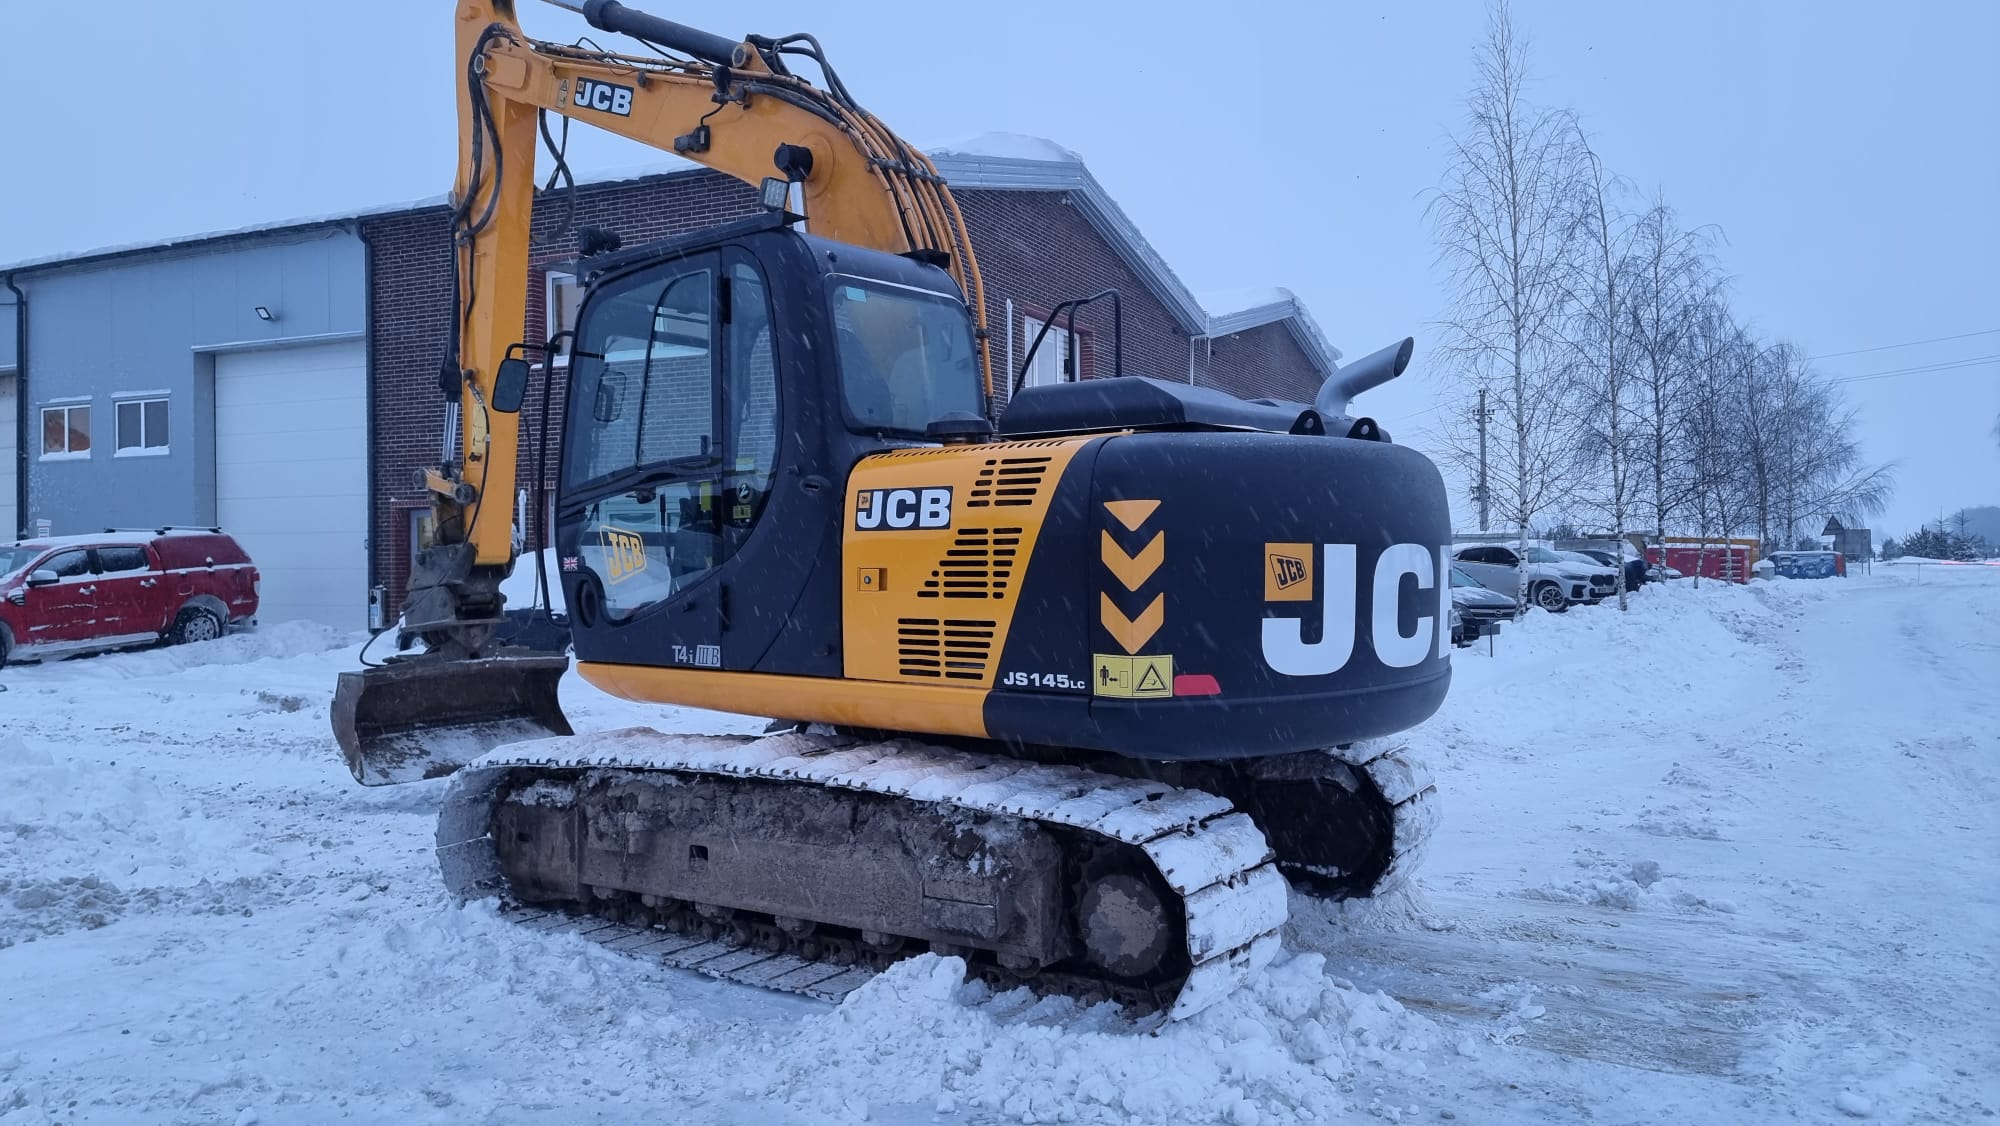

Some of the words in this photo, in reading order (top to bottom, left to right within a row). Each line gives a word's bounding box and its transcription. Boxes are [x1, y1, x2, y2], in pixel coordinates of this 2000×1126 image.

[575, 81, 632, 115] JCB
[857, 488, 951, 529] JCB
[608, 532, 643, 577] JCB
[1277, 557, 1305, 586] JCB
